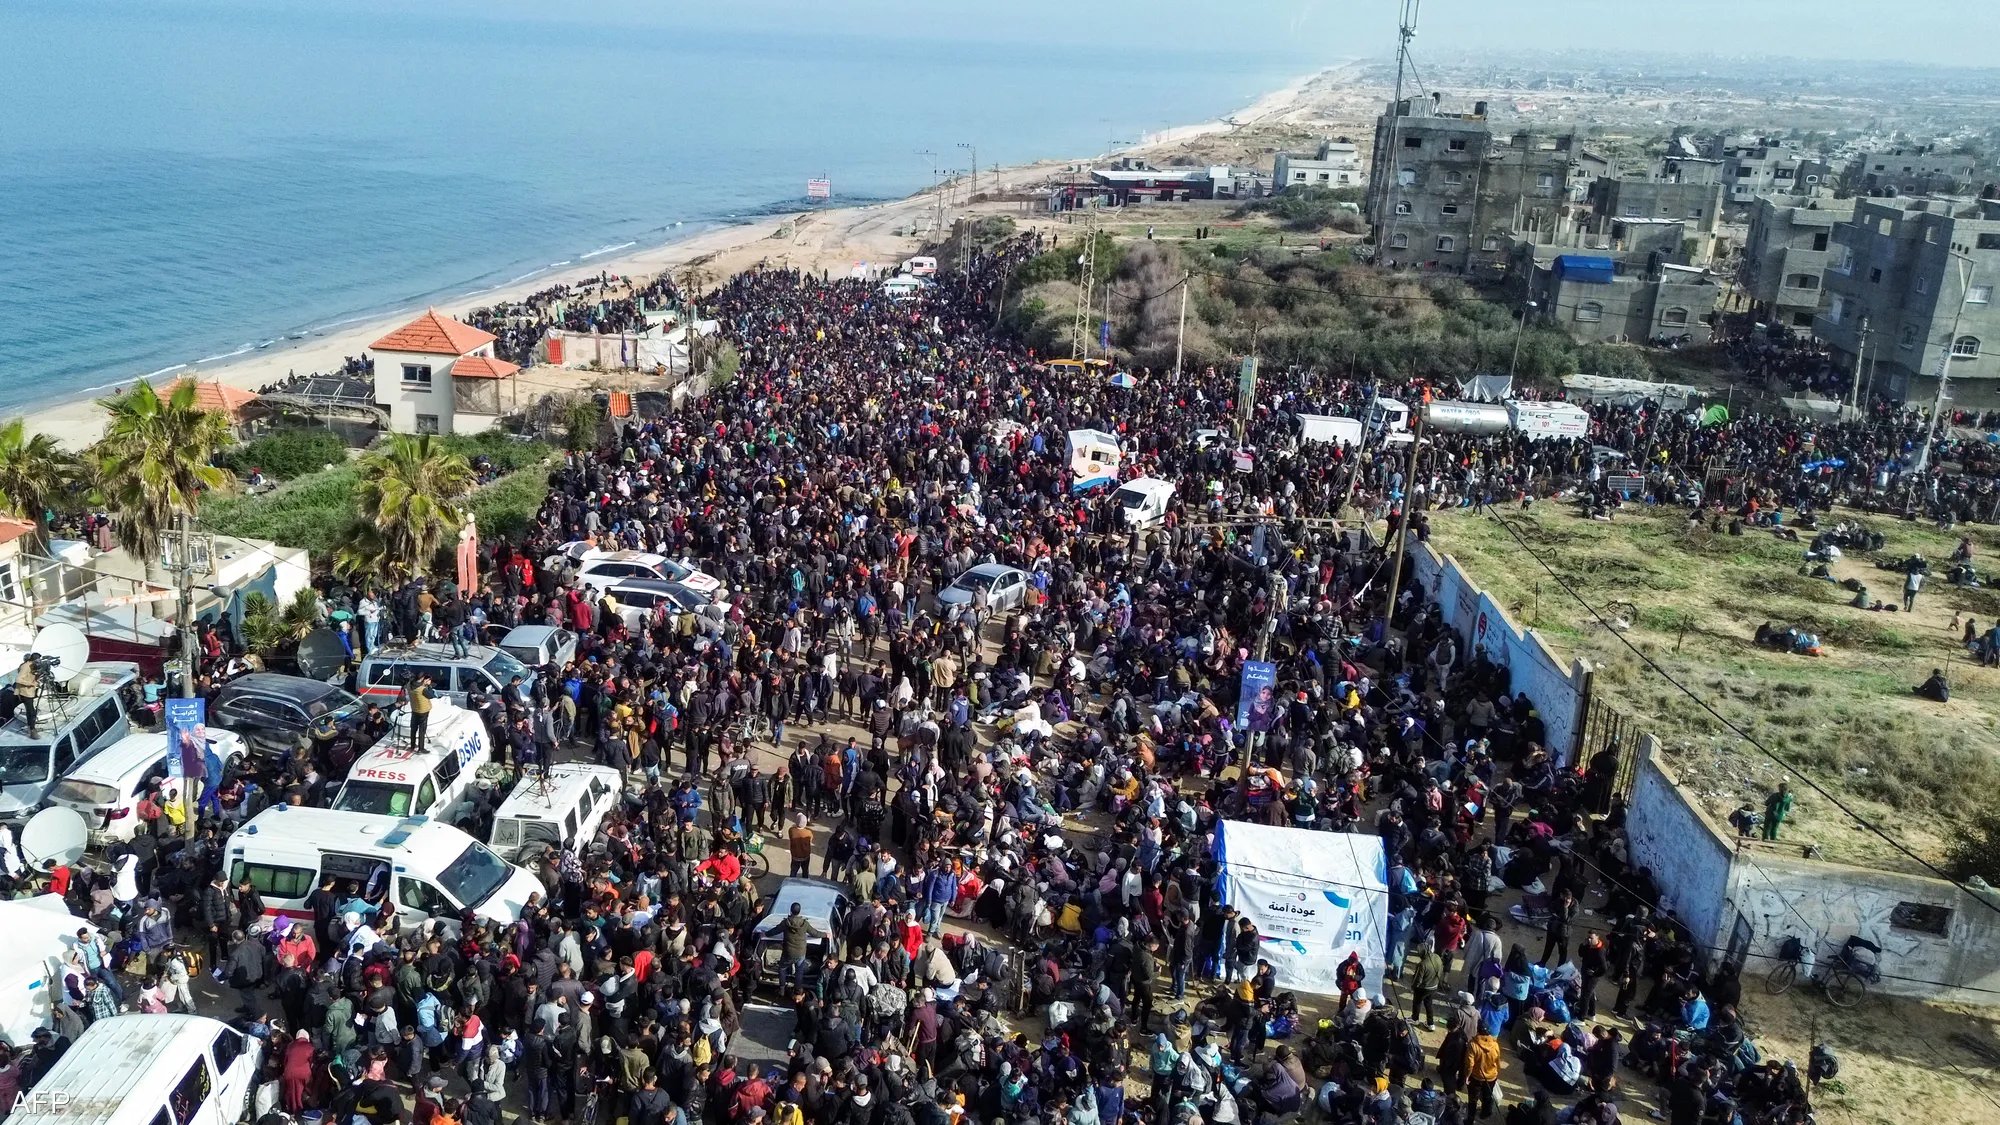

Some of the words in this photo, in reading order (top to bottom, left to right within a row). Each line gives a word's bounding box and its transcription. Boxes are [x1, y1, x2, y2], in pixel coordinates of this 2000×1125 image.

[458, 731, 482, 768] DSNG
[357, 768, 407, 781] PRESS
[1268, 901, 1289, 912] آمنة
[1290, 904, 1315, 917] عودة
